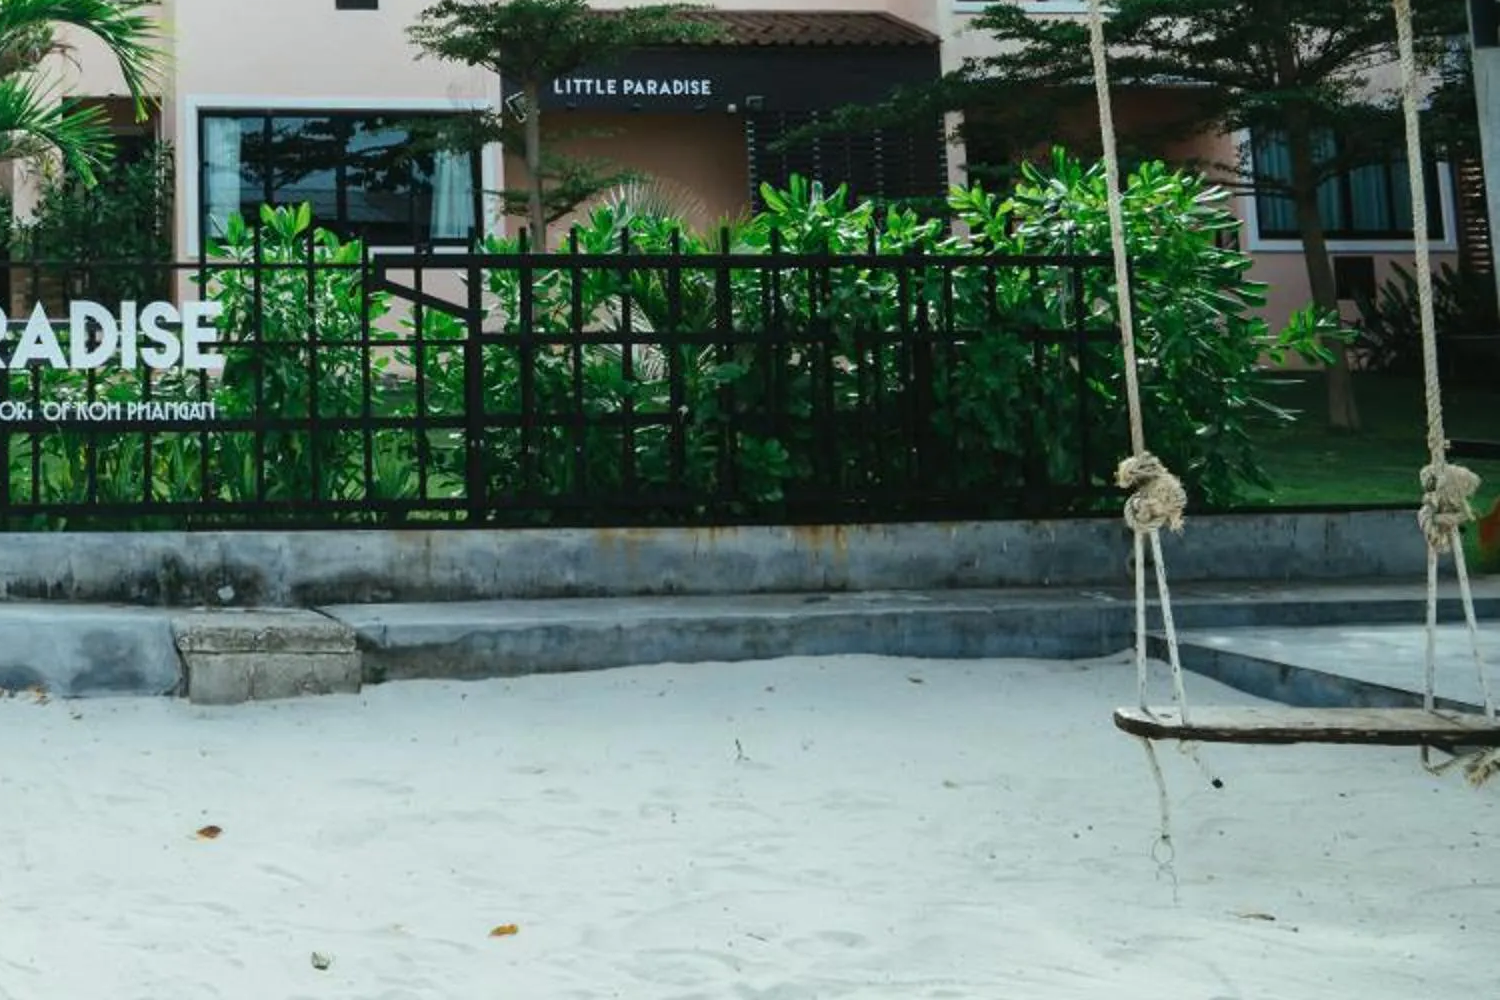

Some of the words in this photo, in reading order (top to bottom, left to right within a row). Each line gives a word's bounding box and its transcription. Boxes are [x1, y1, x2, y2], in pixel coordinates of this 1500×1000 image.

[553, 78, 617, 95] LITTLE
[623, 79, 712, 96] PARADISE
[43, 400, 70, 421] OF
[76, 400, 121, 421] KOH
